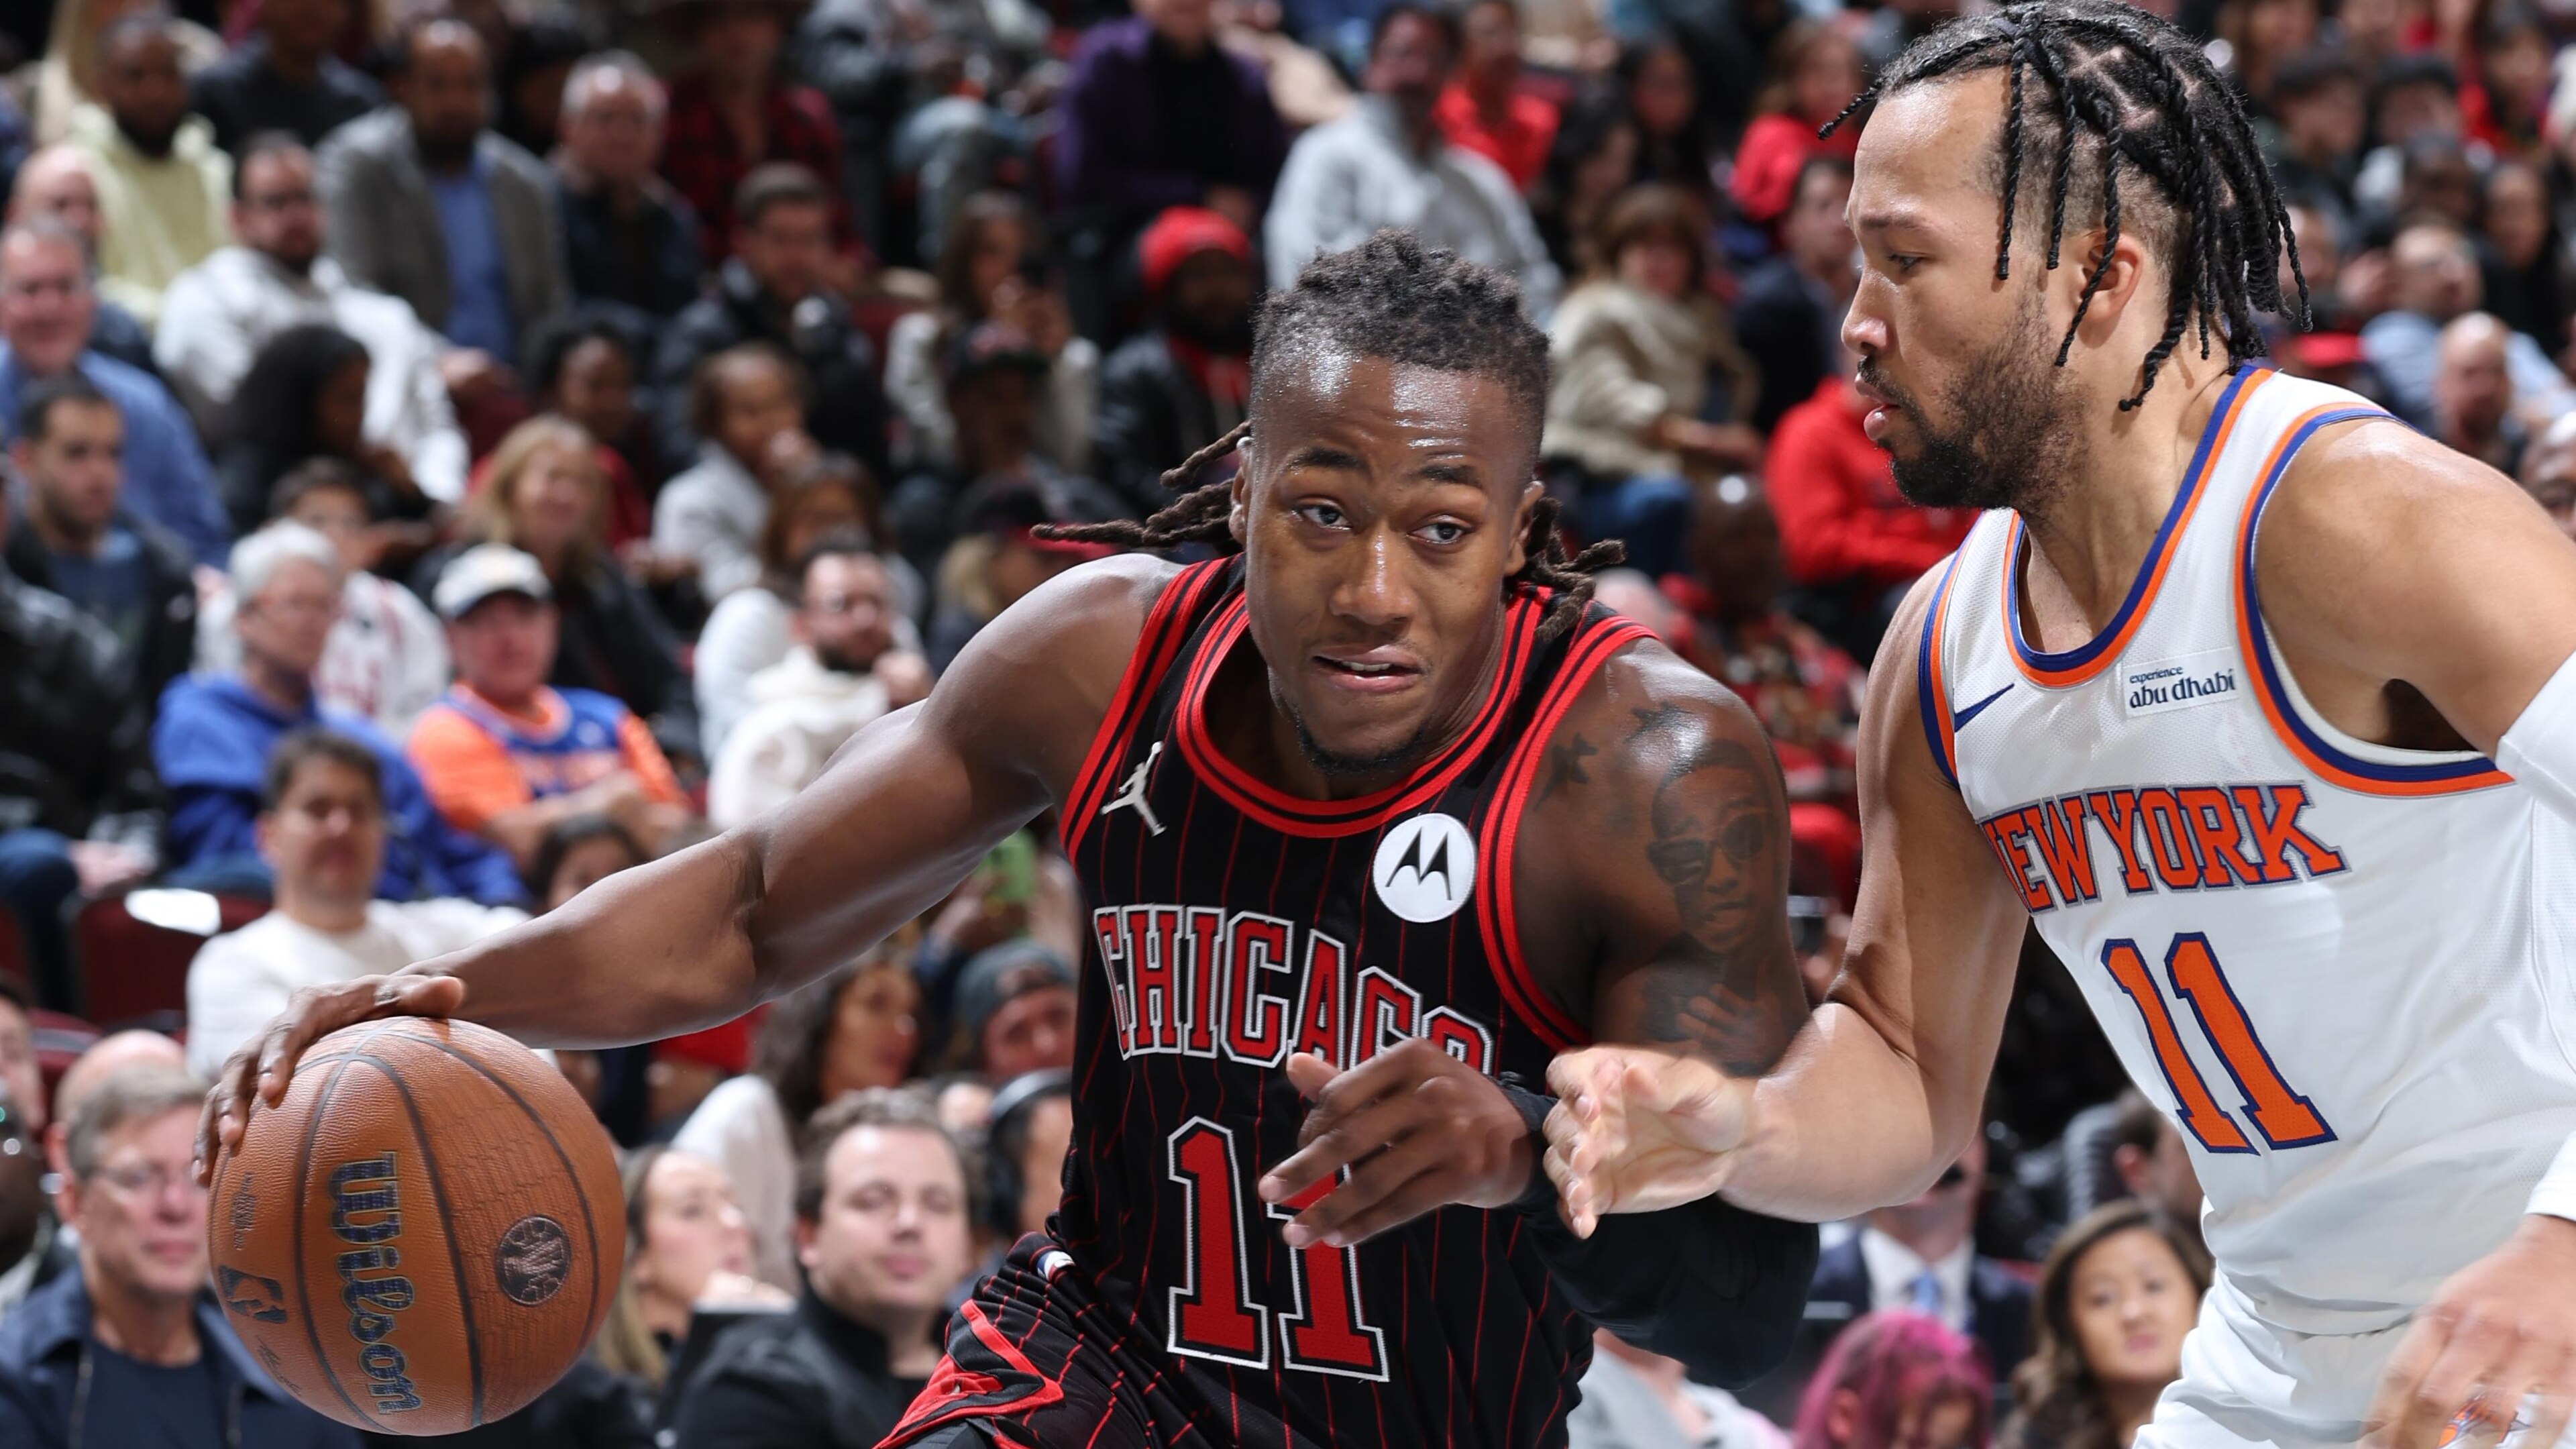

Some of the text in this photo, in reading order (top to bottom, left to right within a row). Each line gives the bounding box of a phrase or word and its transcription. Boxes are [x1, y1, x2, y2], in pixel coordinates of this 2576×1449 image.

[2129, 666, 2183, 685] experience
[2129, 668, 2236, 708] abu dhabi
[2082, 780, 2352, 898] YORK
[2100, 931, 2339, 1157] 11
[326, 1150, 423, 1415] Wilson
[1168, 1116, 1390, 1384] 11
